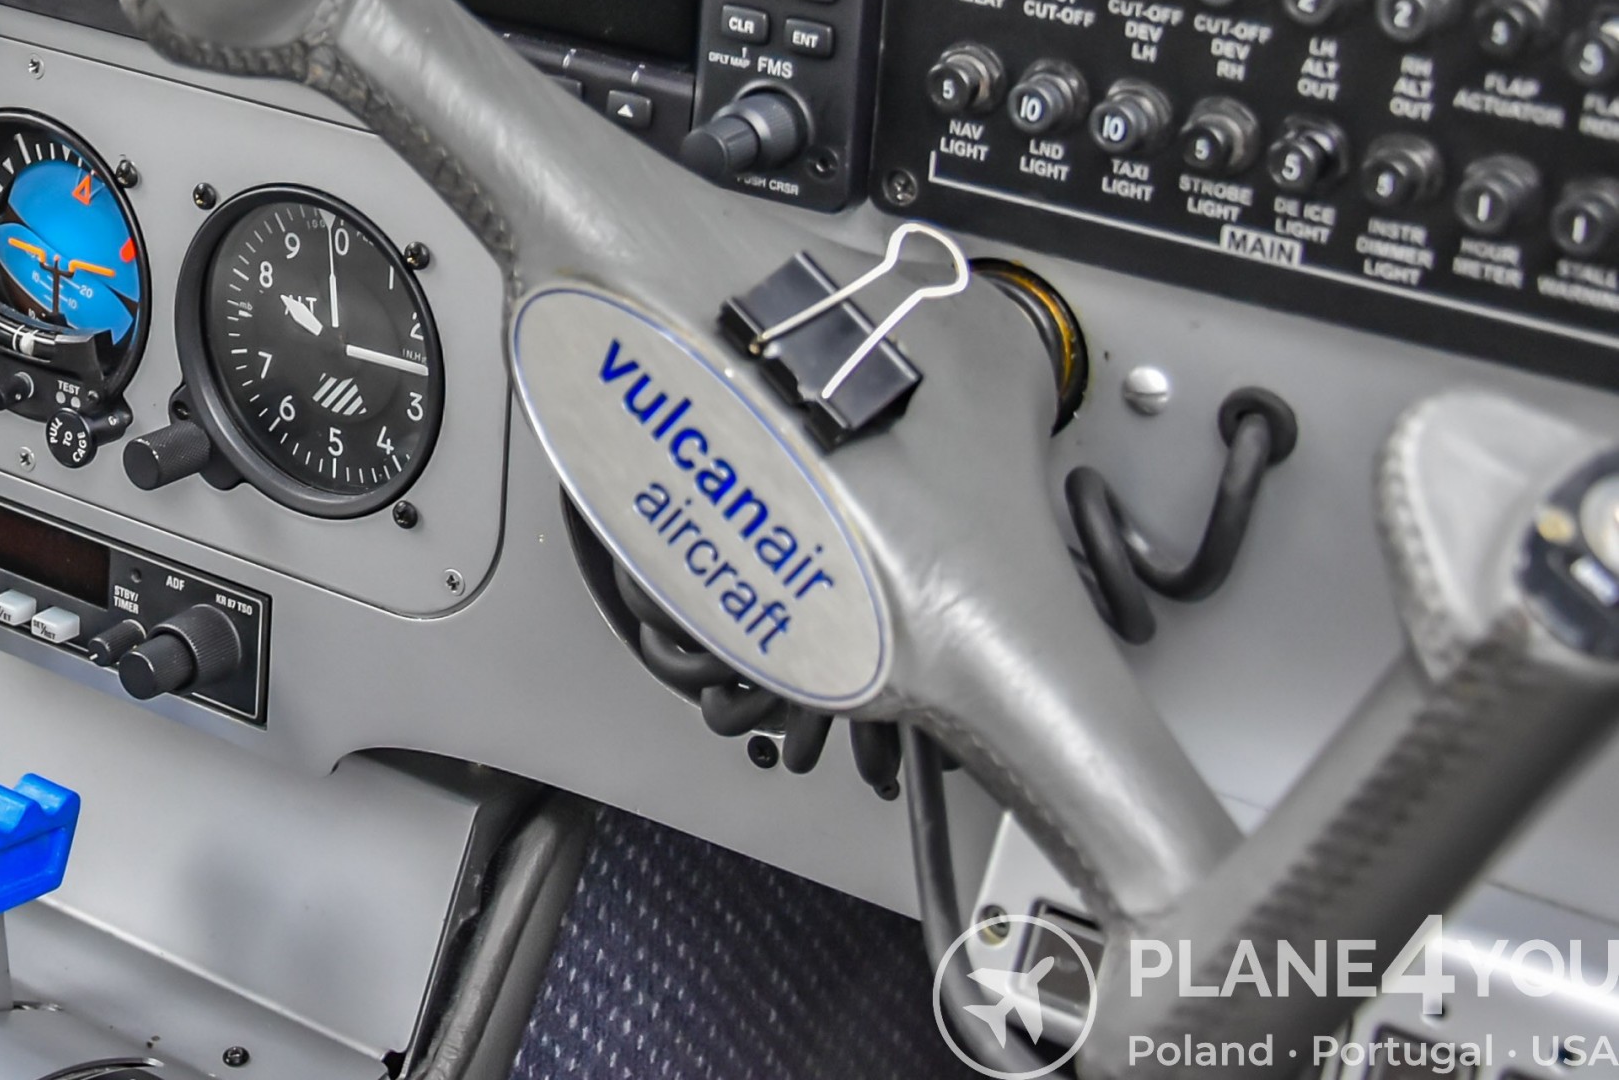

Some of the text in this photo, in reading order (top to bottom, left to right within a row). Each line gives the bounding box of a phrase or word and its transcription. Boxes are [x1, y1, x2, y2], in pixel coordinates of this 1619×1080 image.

[729, 16, 754, 34] CLR
[1023, 0, 1096, 27] CUT-OFF
[793, 31, 818, 48] ENT
[1125, 20, 1163, 43] DEV
[758, 56, 794, 80] FMS
[1020, 96, 1042, 120] 10
[949, 120, 983, 141] NAV
[1103, 114, 1125, 142] 10
[940, 136, 989, 161] LIGHT
[1029, 139, 1065, 161] LND
[1020, 156, 1070, 182] LIGHT
[1112, 159, 1150, 181] TAXI
[1102, 176, 1154, 202] LIGHT
[1187, 196, 1241, 223] LIGHT
[285, 232, 301, 259] 9
[334, 227, 349, 256] 0
[1227, 226, 1295, 265] MAIN
[259, 261, 273, 288] 8
[80, 285, 94, 298] 20
[258, 351, 272, 379] 7
[57, 380, 80, 395] TEST
[279, 395, 295, 420] 6
[407, 392, 424, 420] 3
[49, 417, 63, 443] PULL
[62, 431, 73, 446] TO
[328, 427, 343, 456] 5
[377, 426, 394, 454] 4
[72, 431, 87, 462] CAGE
[598, 338, 834, 600] vulcanair
[634, 481, 790, 654] aircraft
[114, 585, 139, 602] STBY/
[166, 575, 185, 591] ADF
[114, 596, 139, 614] TIMER
[216, 594, 253, 616] KR 87 TSO
